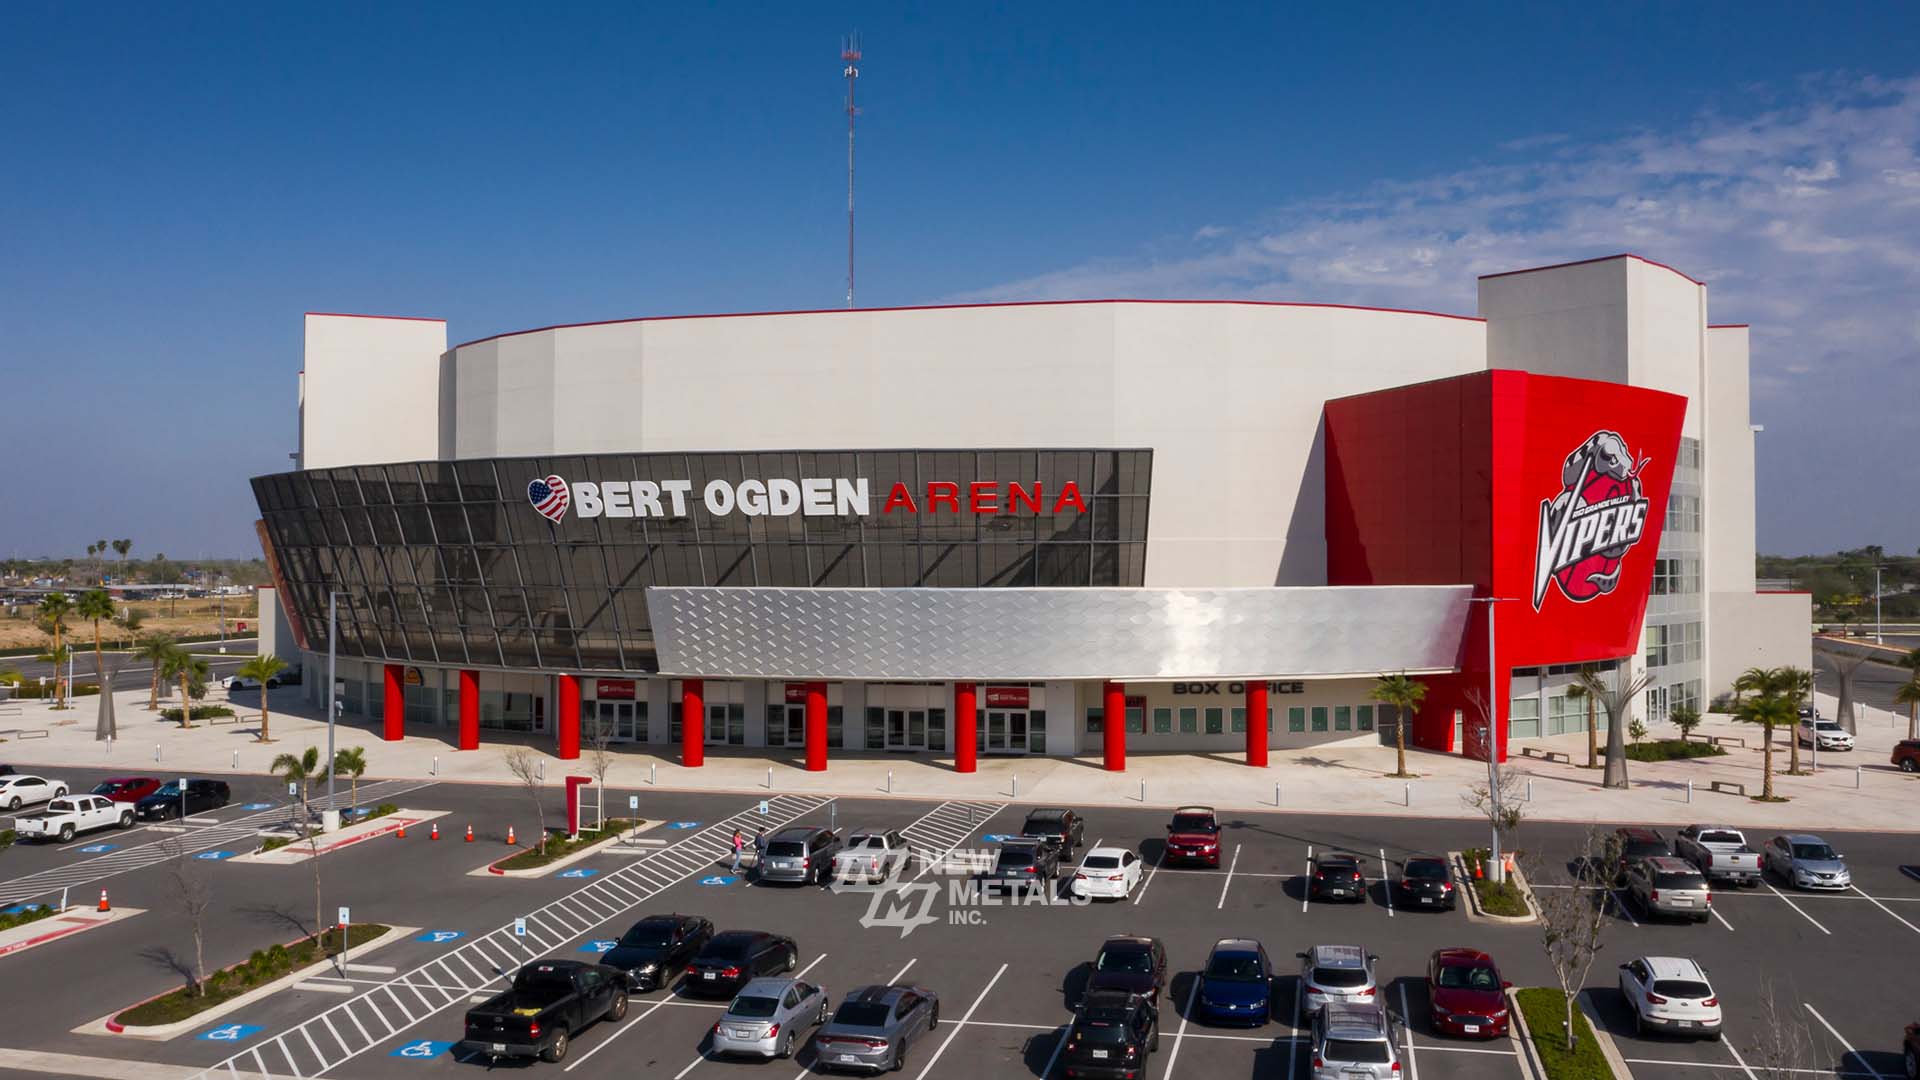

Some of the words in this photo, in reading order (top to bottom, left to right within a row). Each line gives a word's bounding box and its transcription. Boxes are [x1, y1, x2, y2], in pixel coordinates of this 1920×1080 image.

[571, 480, 692, 518] BERT
[703, 478, 870, 517] OGDEN
[883, 481, 1087, 513] ARENA
[1535, 456, 1648, 604] VIPERS
[1173, 682, 1220, 695] BOX
[1228, 681, 1305, 695] OICE
